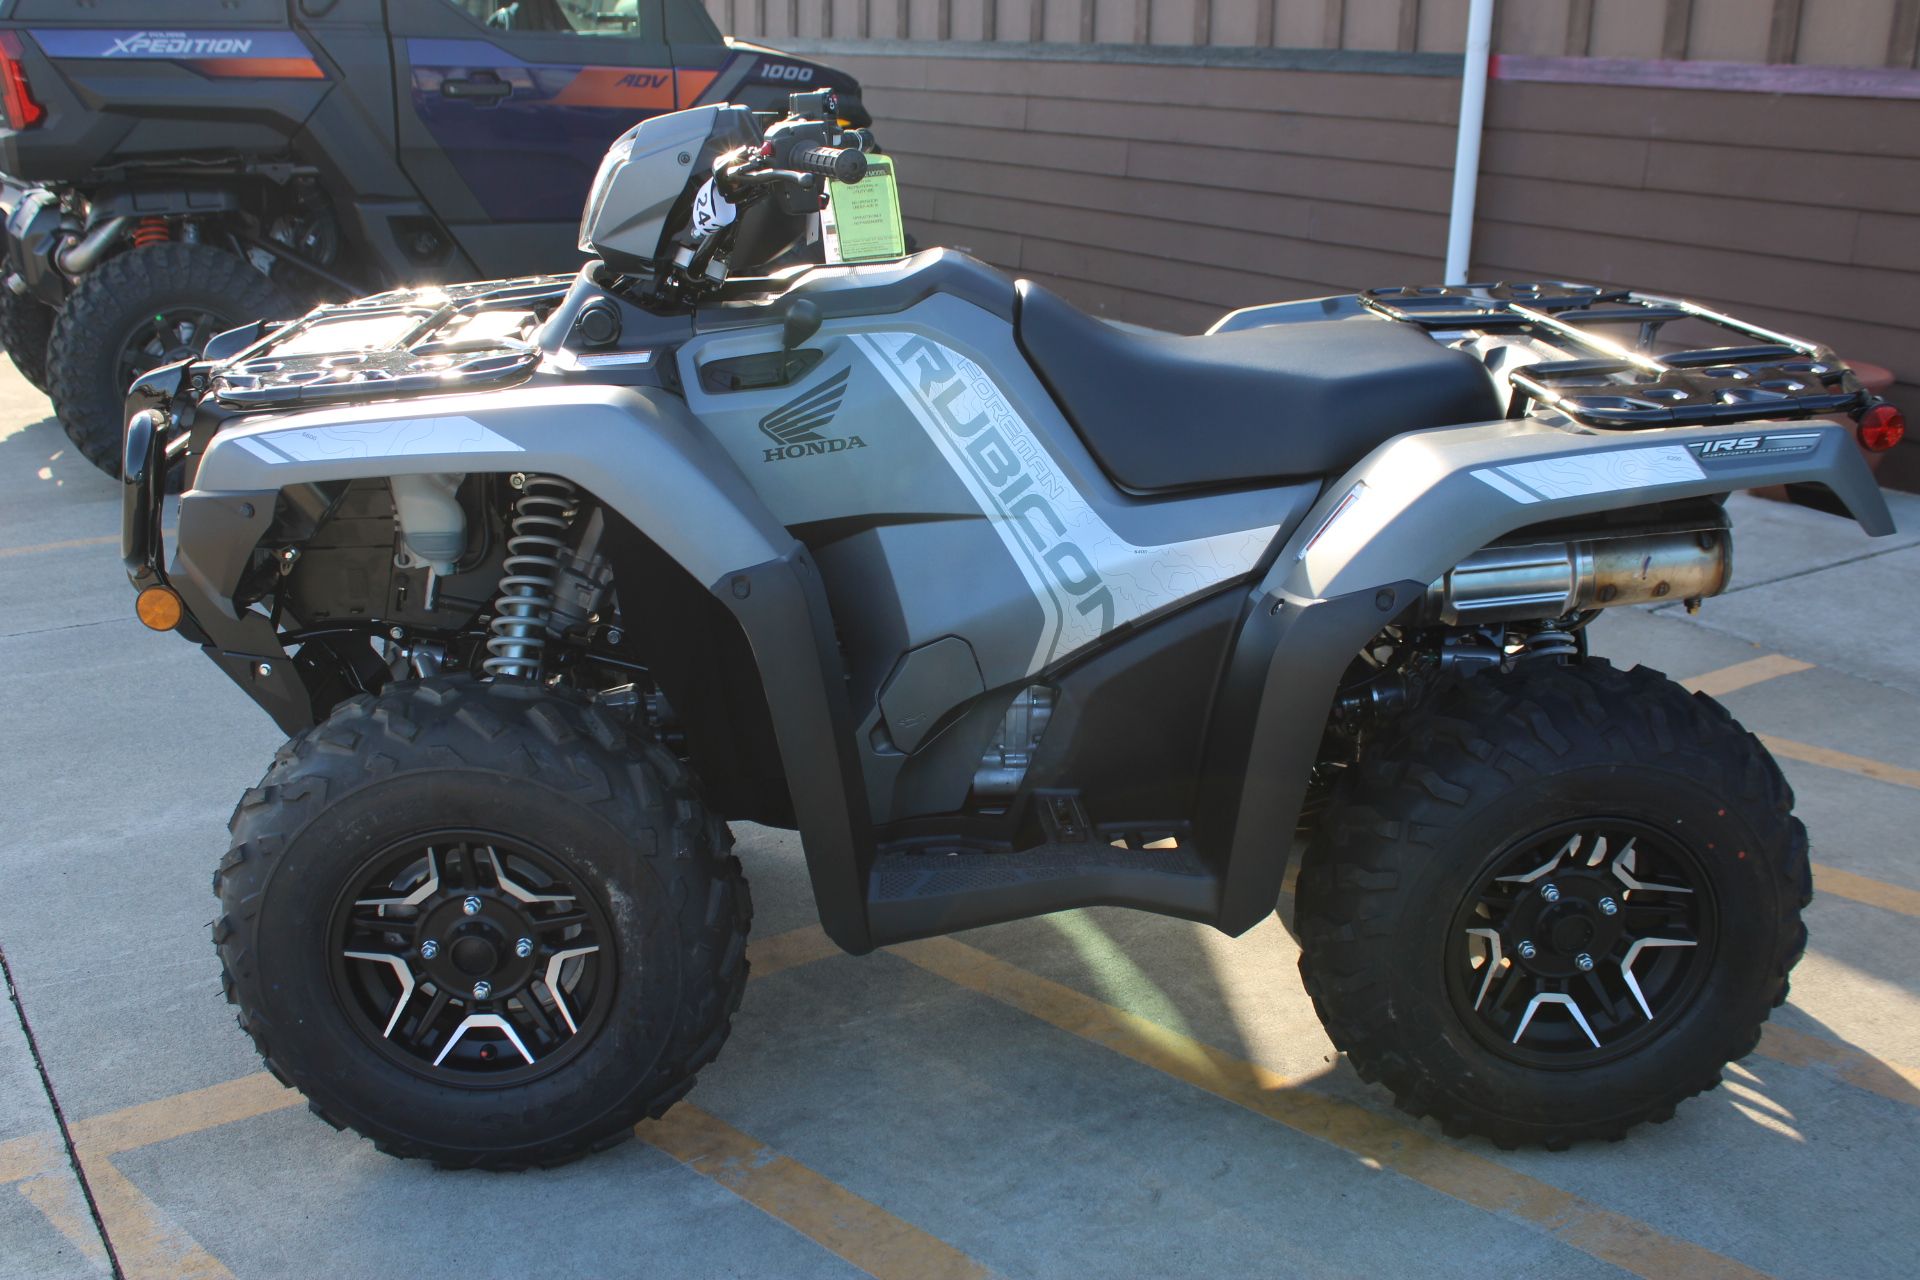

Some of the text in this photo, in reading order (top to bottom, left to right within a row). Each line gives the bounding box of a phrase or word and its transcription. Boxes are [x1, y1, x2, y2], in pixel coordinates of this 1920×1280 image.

[102, 31, 252, 56] XPEDITION
[614, 74, 668, 88] ADV
[761, 64, 813, 81] 1000
[957, 358, 1064, 500] FOREMAN
[762, 434, 868, 463] HONDA
[1702, 436, 1763, 453] IRS
